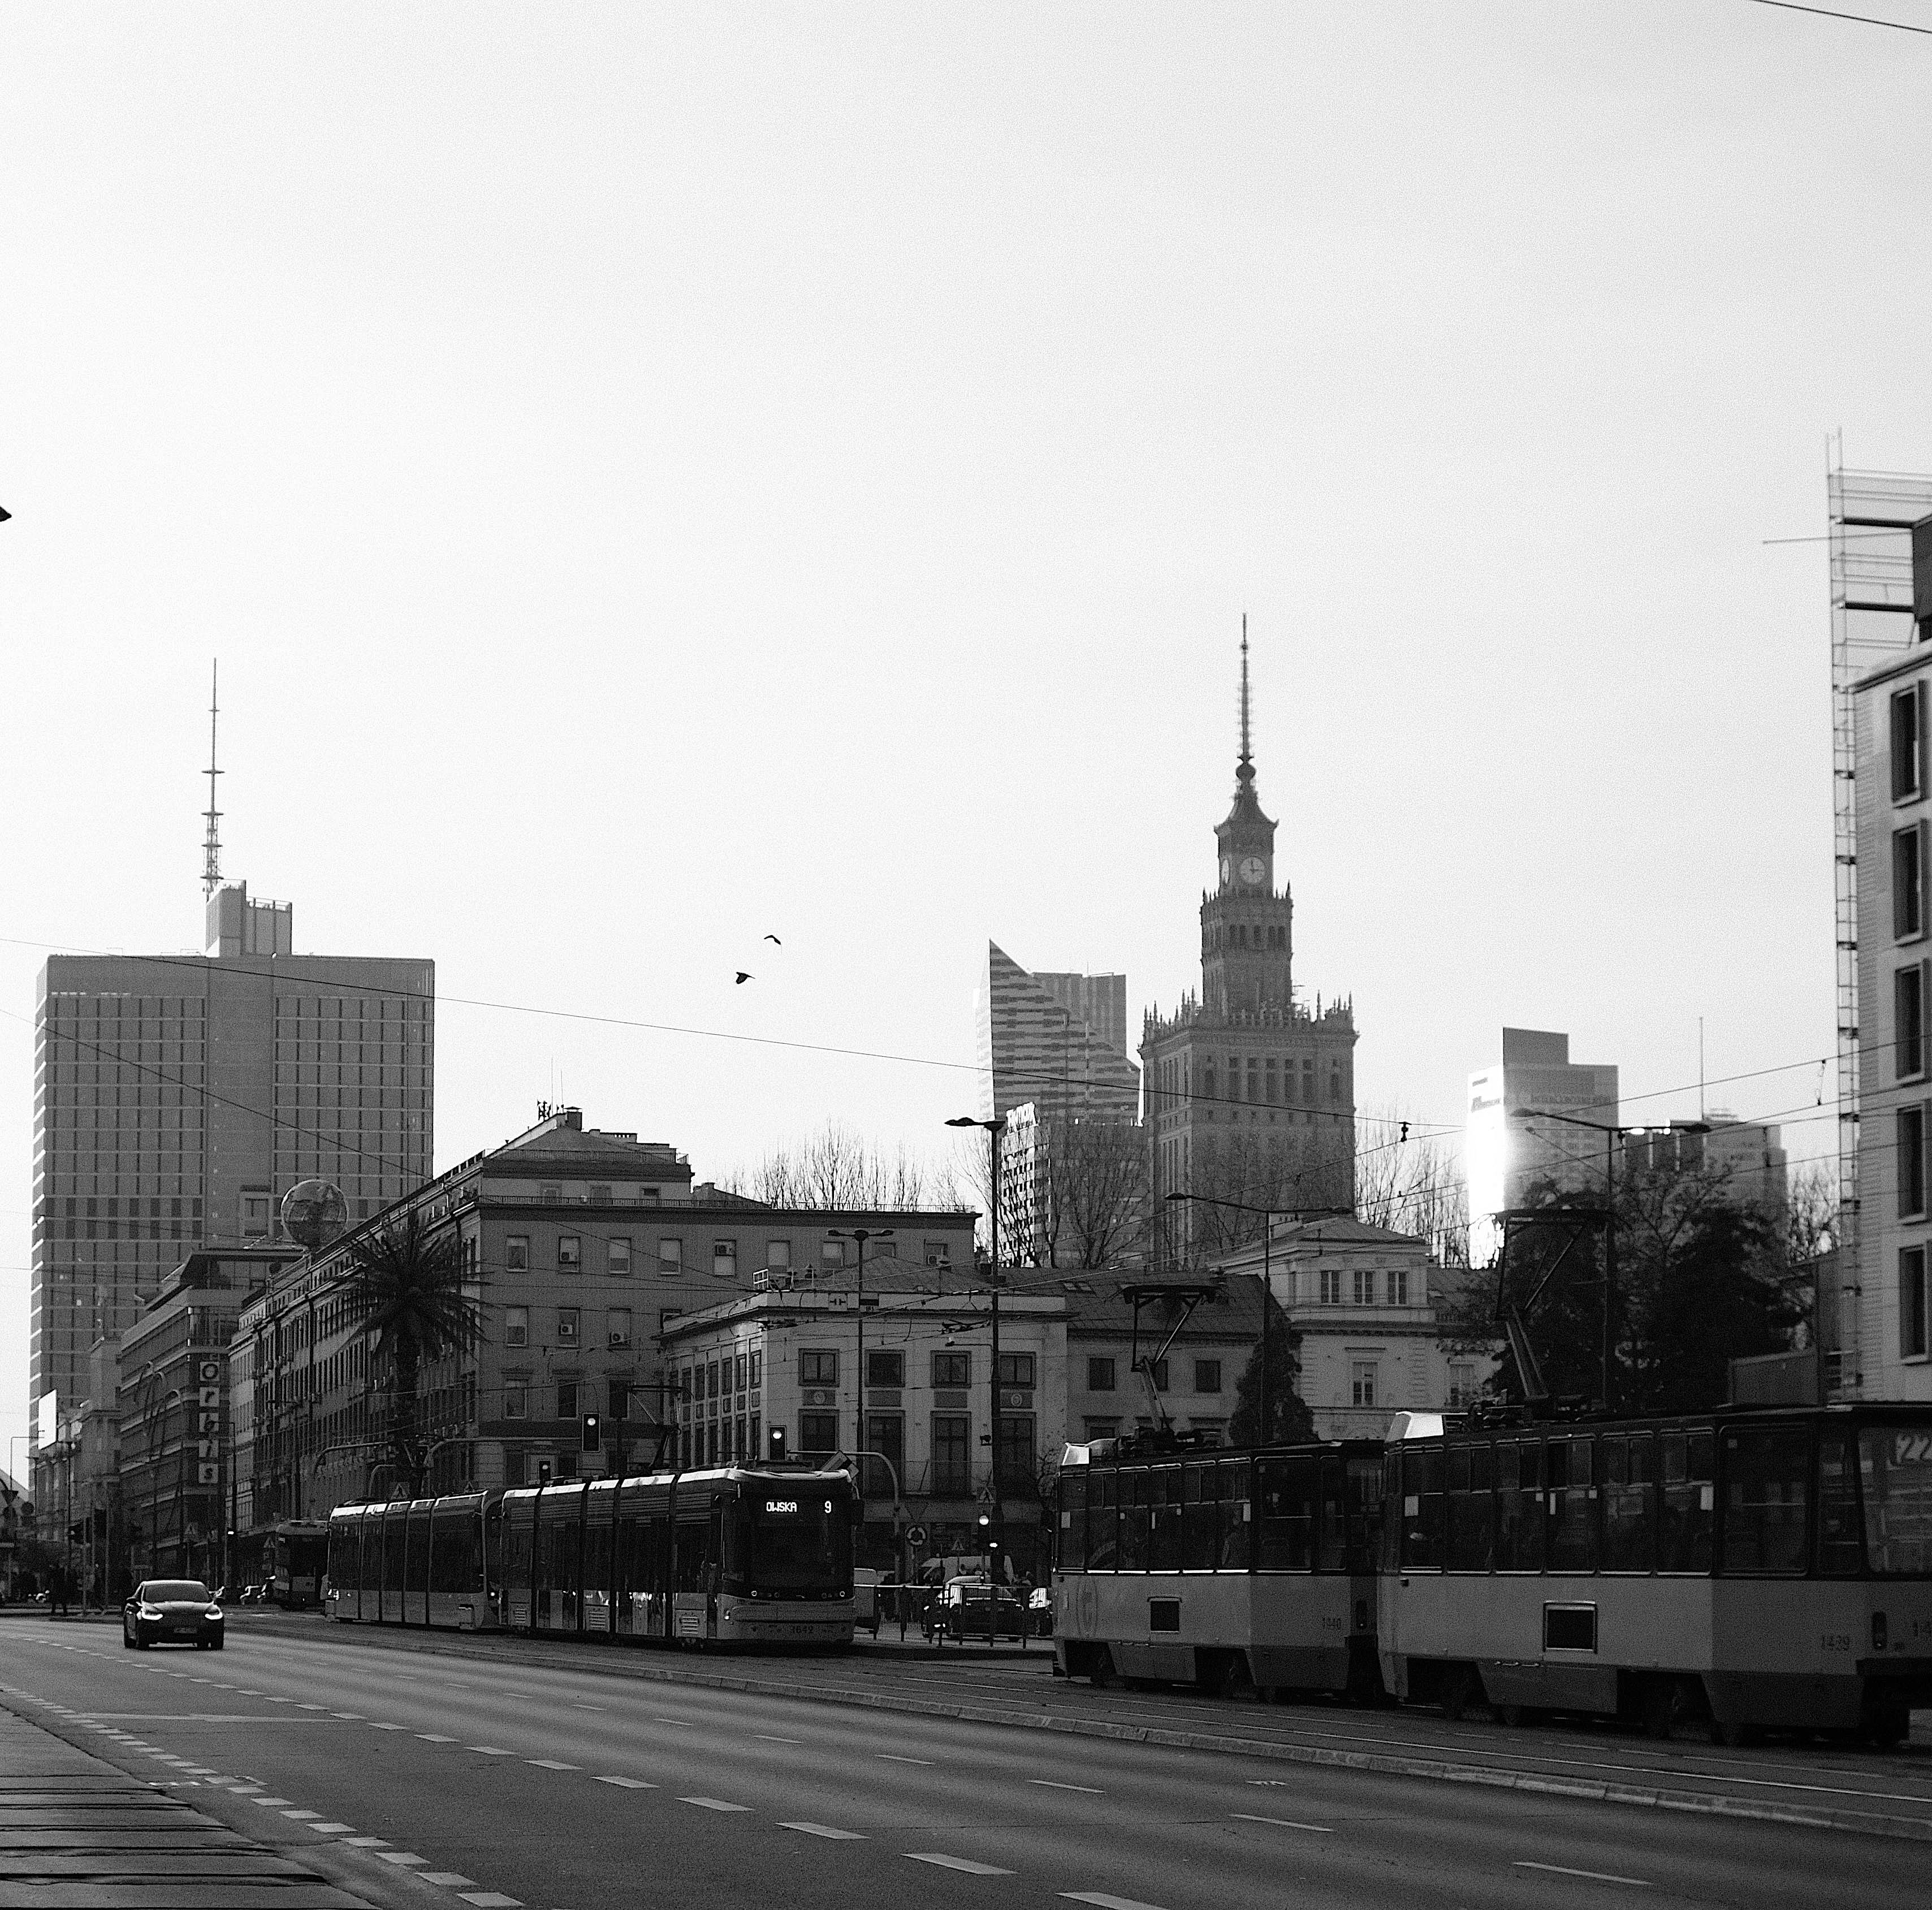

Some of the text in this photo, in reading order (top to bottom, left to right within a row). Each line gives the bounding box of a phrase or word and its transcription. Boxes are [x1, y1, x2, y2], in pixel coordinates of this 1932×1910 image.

[202, 1363, 219, 1480] Orbis
[766, 1500, 832, 1514] OWSKA 9
